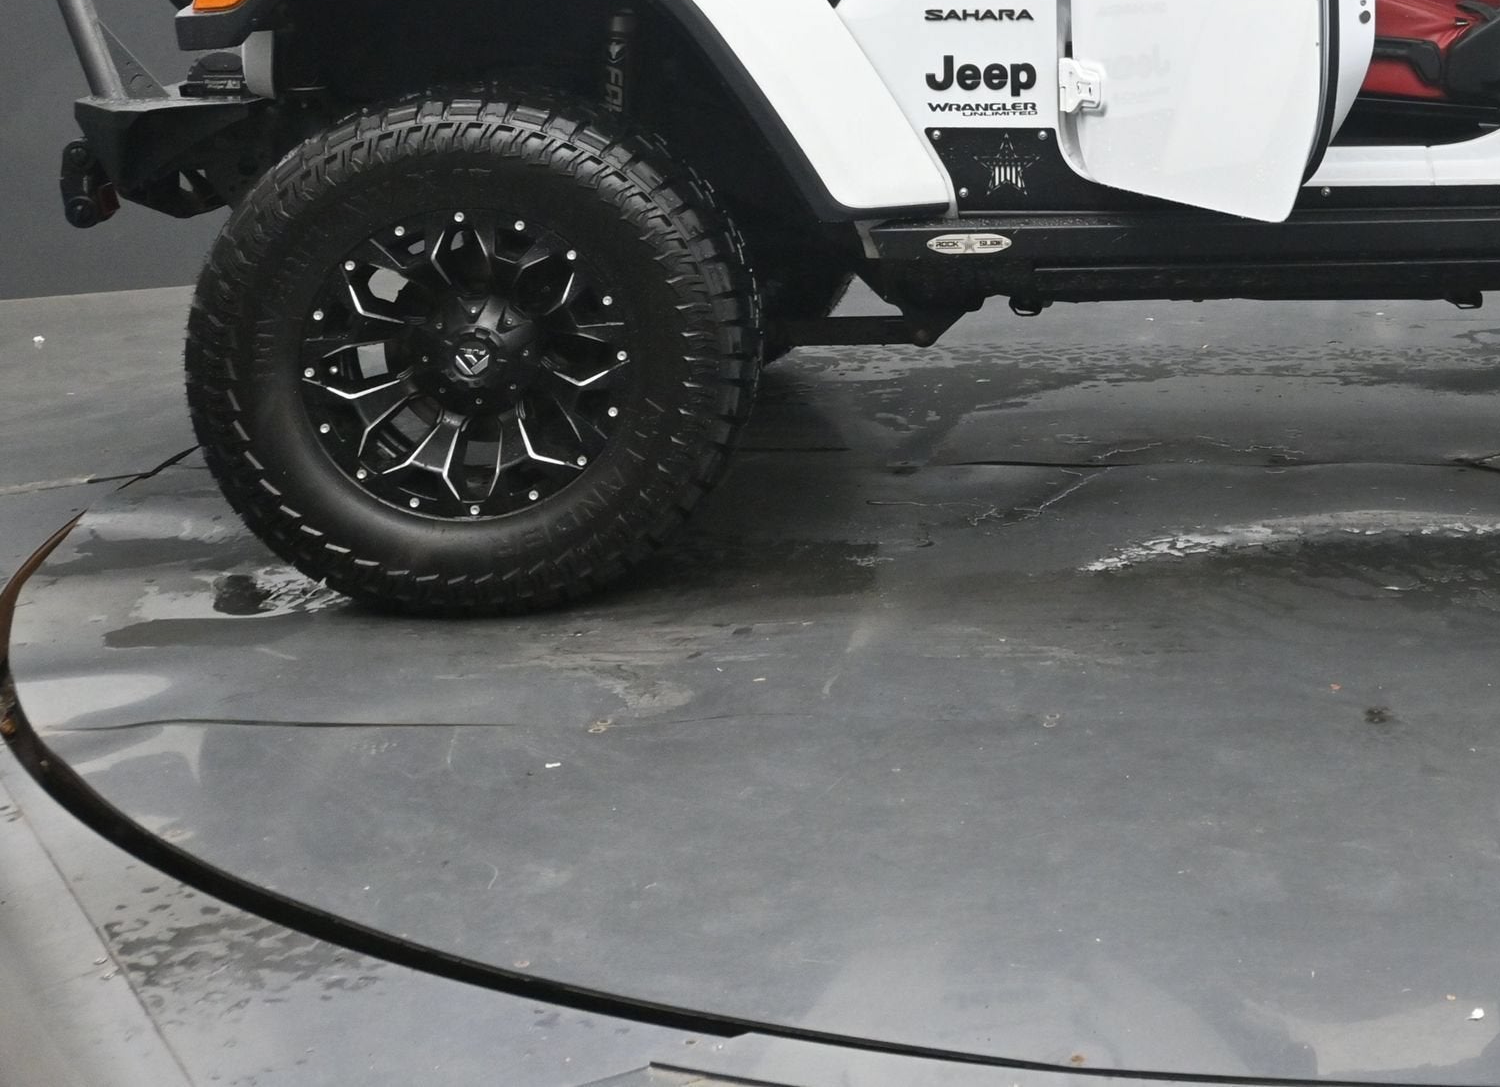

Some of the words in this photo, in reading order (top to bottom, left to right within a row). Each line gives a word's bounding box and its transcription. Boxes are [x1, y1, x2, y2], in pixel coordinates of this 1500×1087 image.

[924, 9, 1034, 21] SAHARA
[925, 54, 1037, 97] Jeep
[927, 102, 1037, 112] WRANGLER
